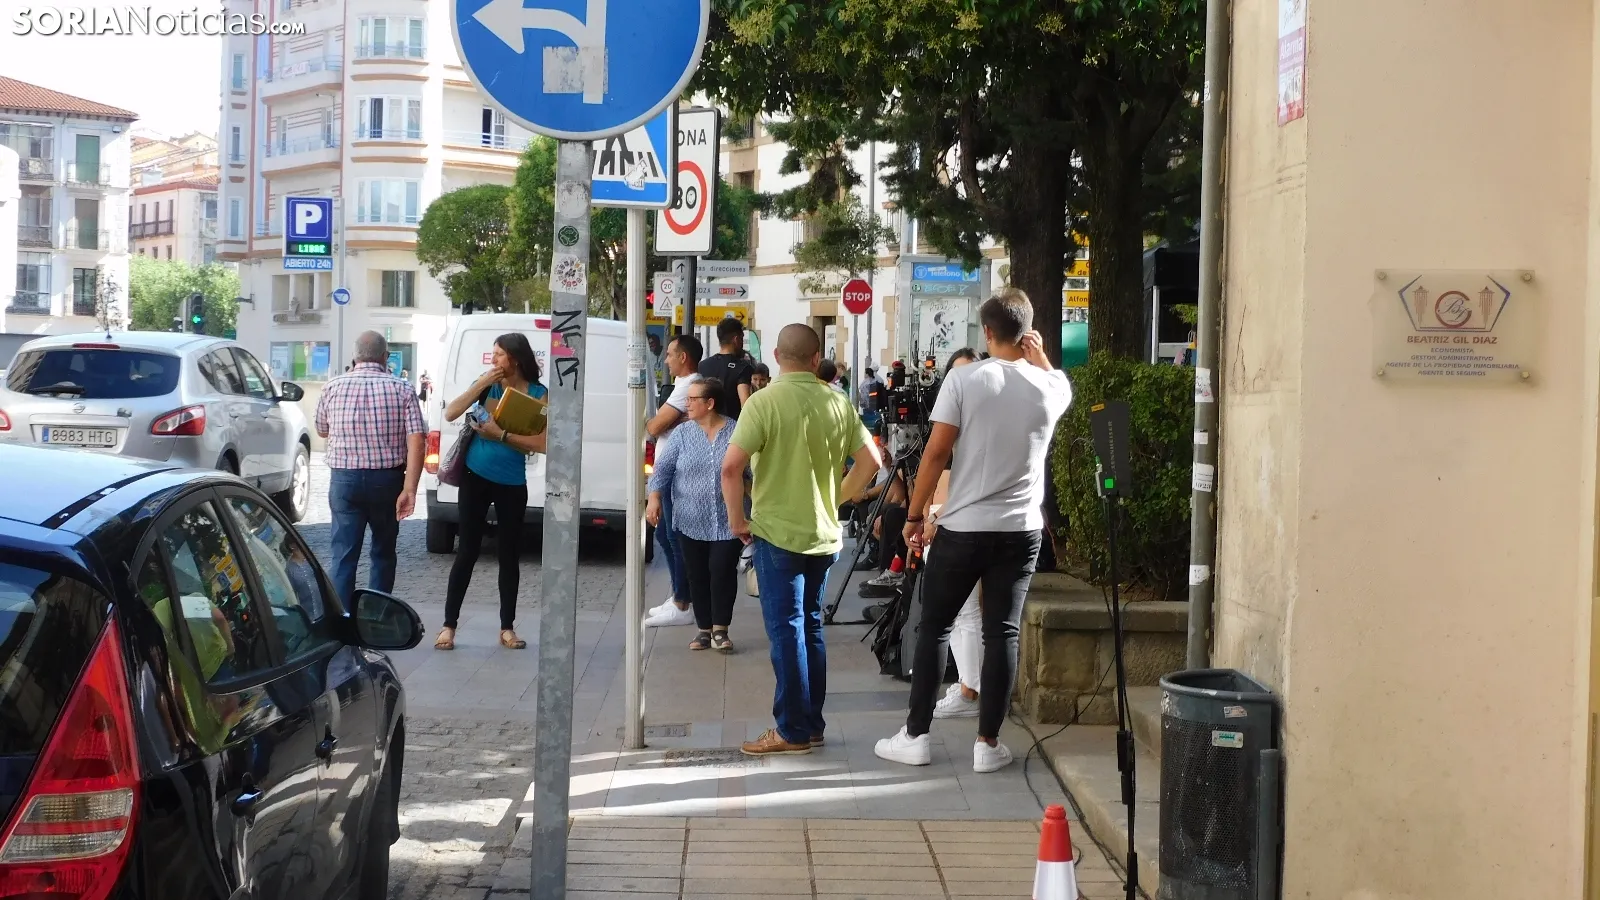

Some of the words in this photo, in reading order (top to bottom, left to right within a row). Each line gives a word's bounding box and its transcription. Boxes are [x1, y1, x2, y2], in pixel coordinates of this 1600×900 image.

[678, 129, 707, 146] ONA
[296, 204, 322, 234] P
[285, 259, 315, 268] ABIERTO
[317, 260, 331, 268] 24h
[845, 292, 871, 301] STOP
[1453, 336, 1469, 344] GIL
[52, 429, 83, 442] 8983
[89, 431, 113, 442] HTG
